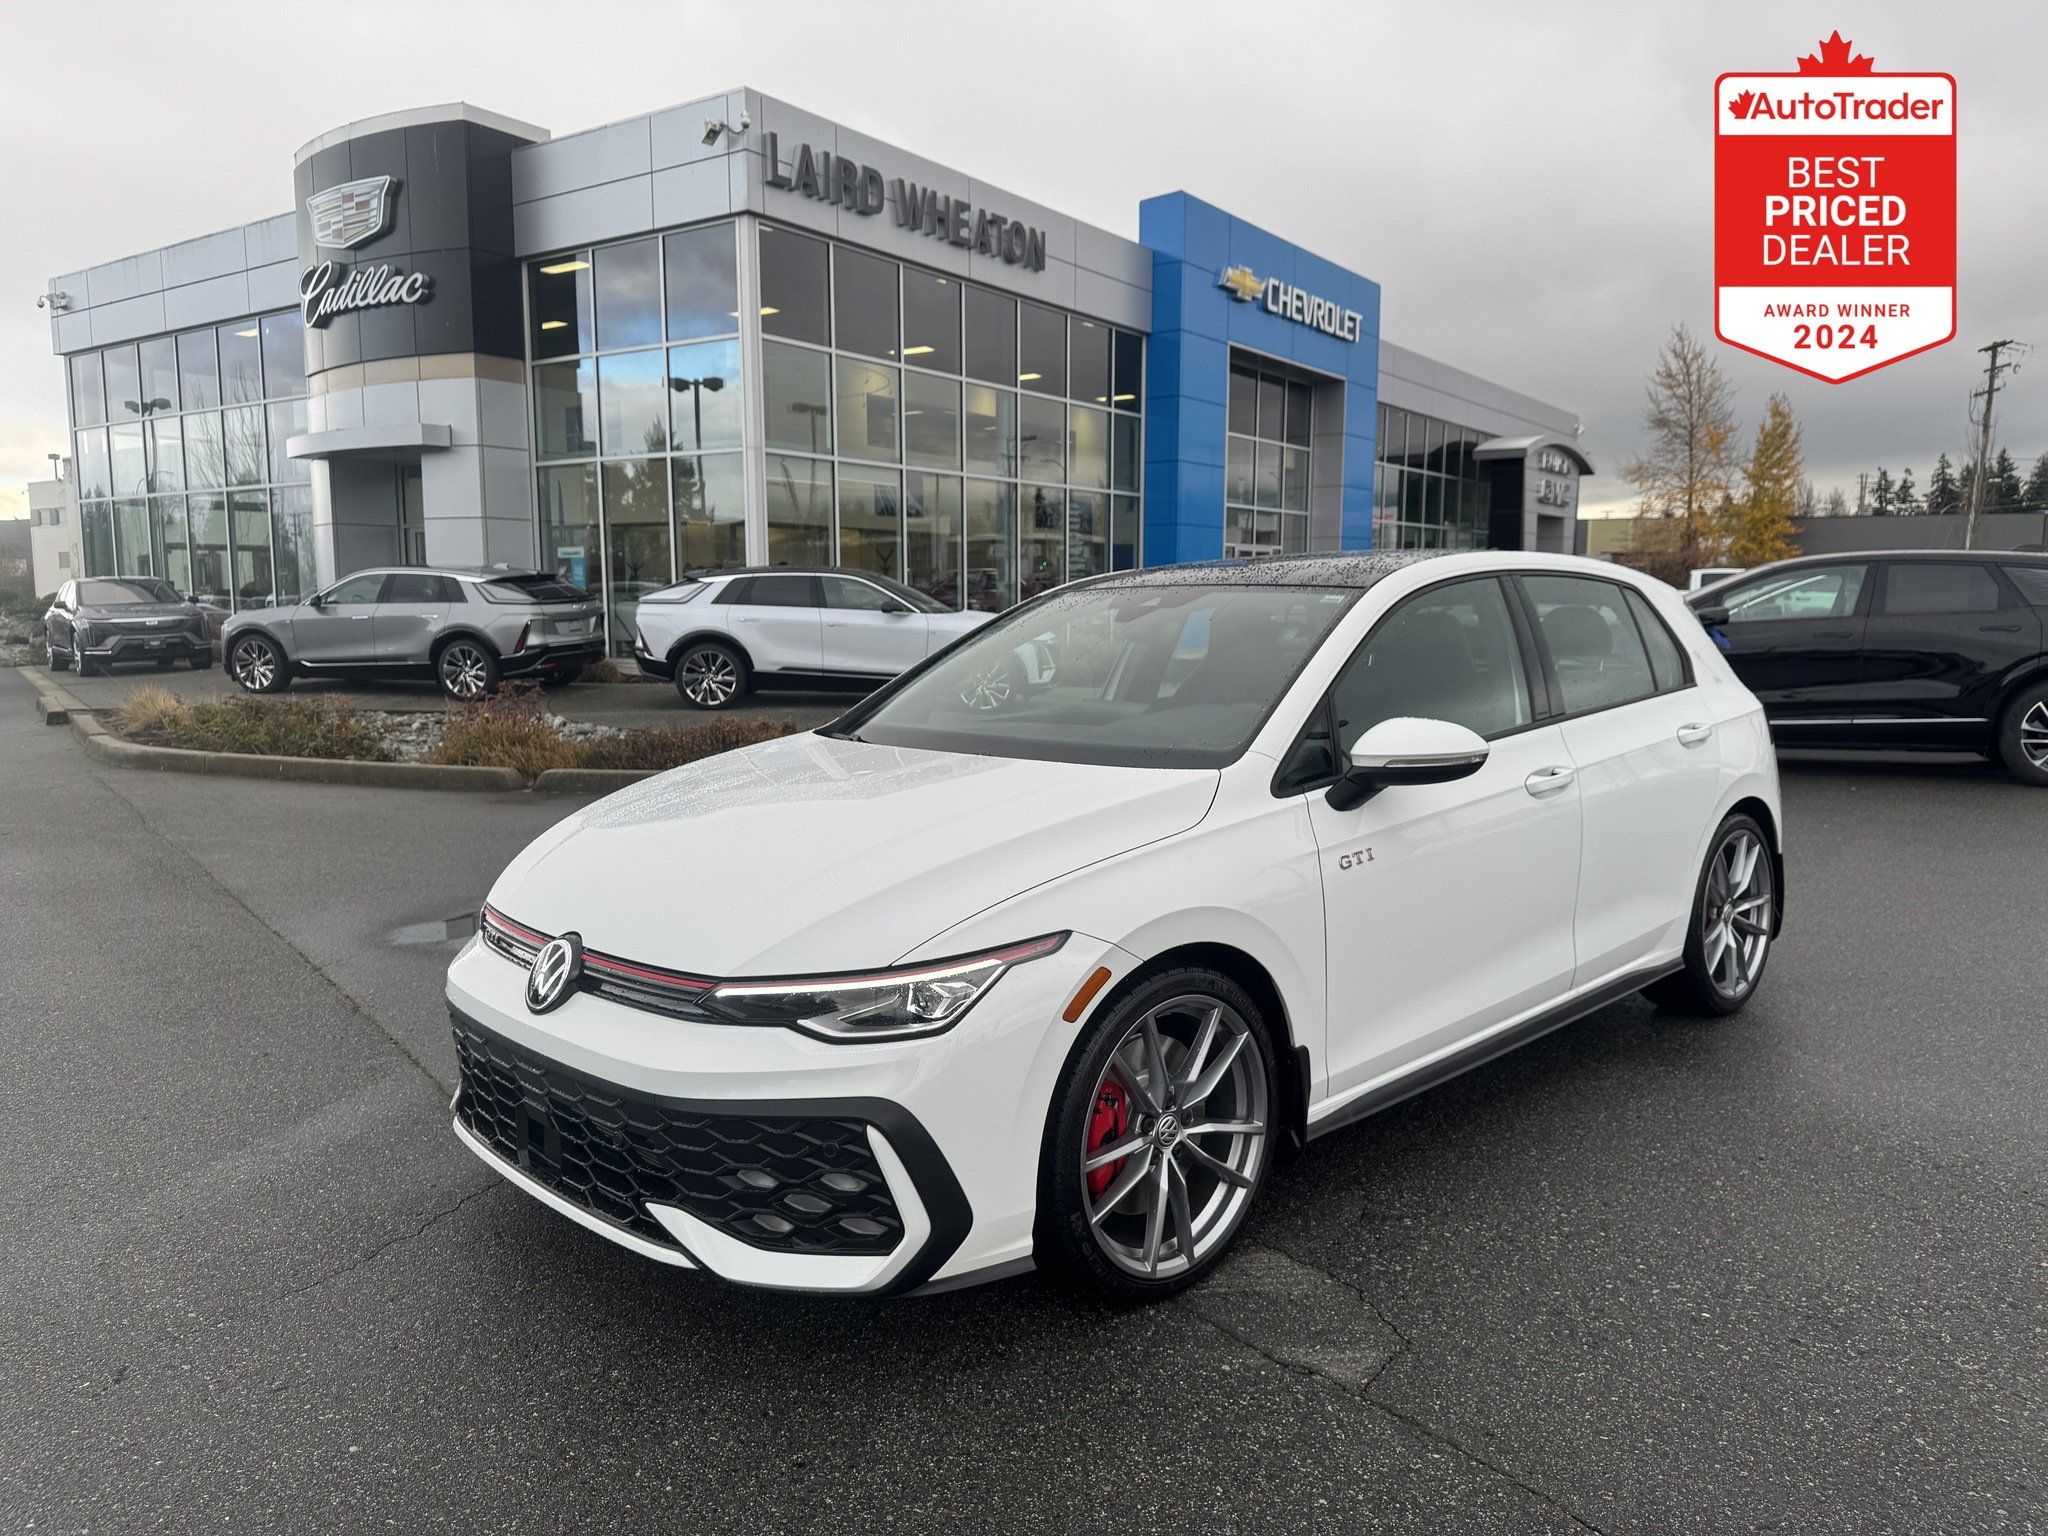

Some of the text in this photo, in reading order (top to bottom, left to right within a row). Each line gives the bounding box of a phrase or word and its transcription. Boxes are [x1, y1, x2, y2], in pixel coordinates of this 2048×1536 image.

[764, 131, 1047, 272] LAIRD WHEATON
[299, 259, 426, 329] Cadillac
[1266, 276, 1364, 344] CHEVROLET
[1338, 847, 1375, 870] GTI
